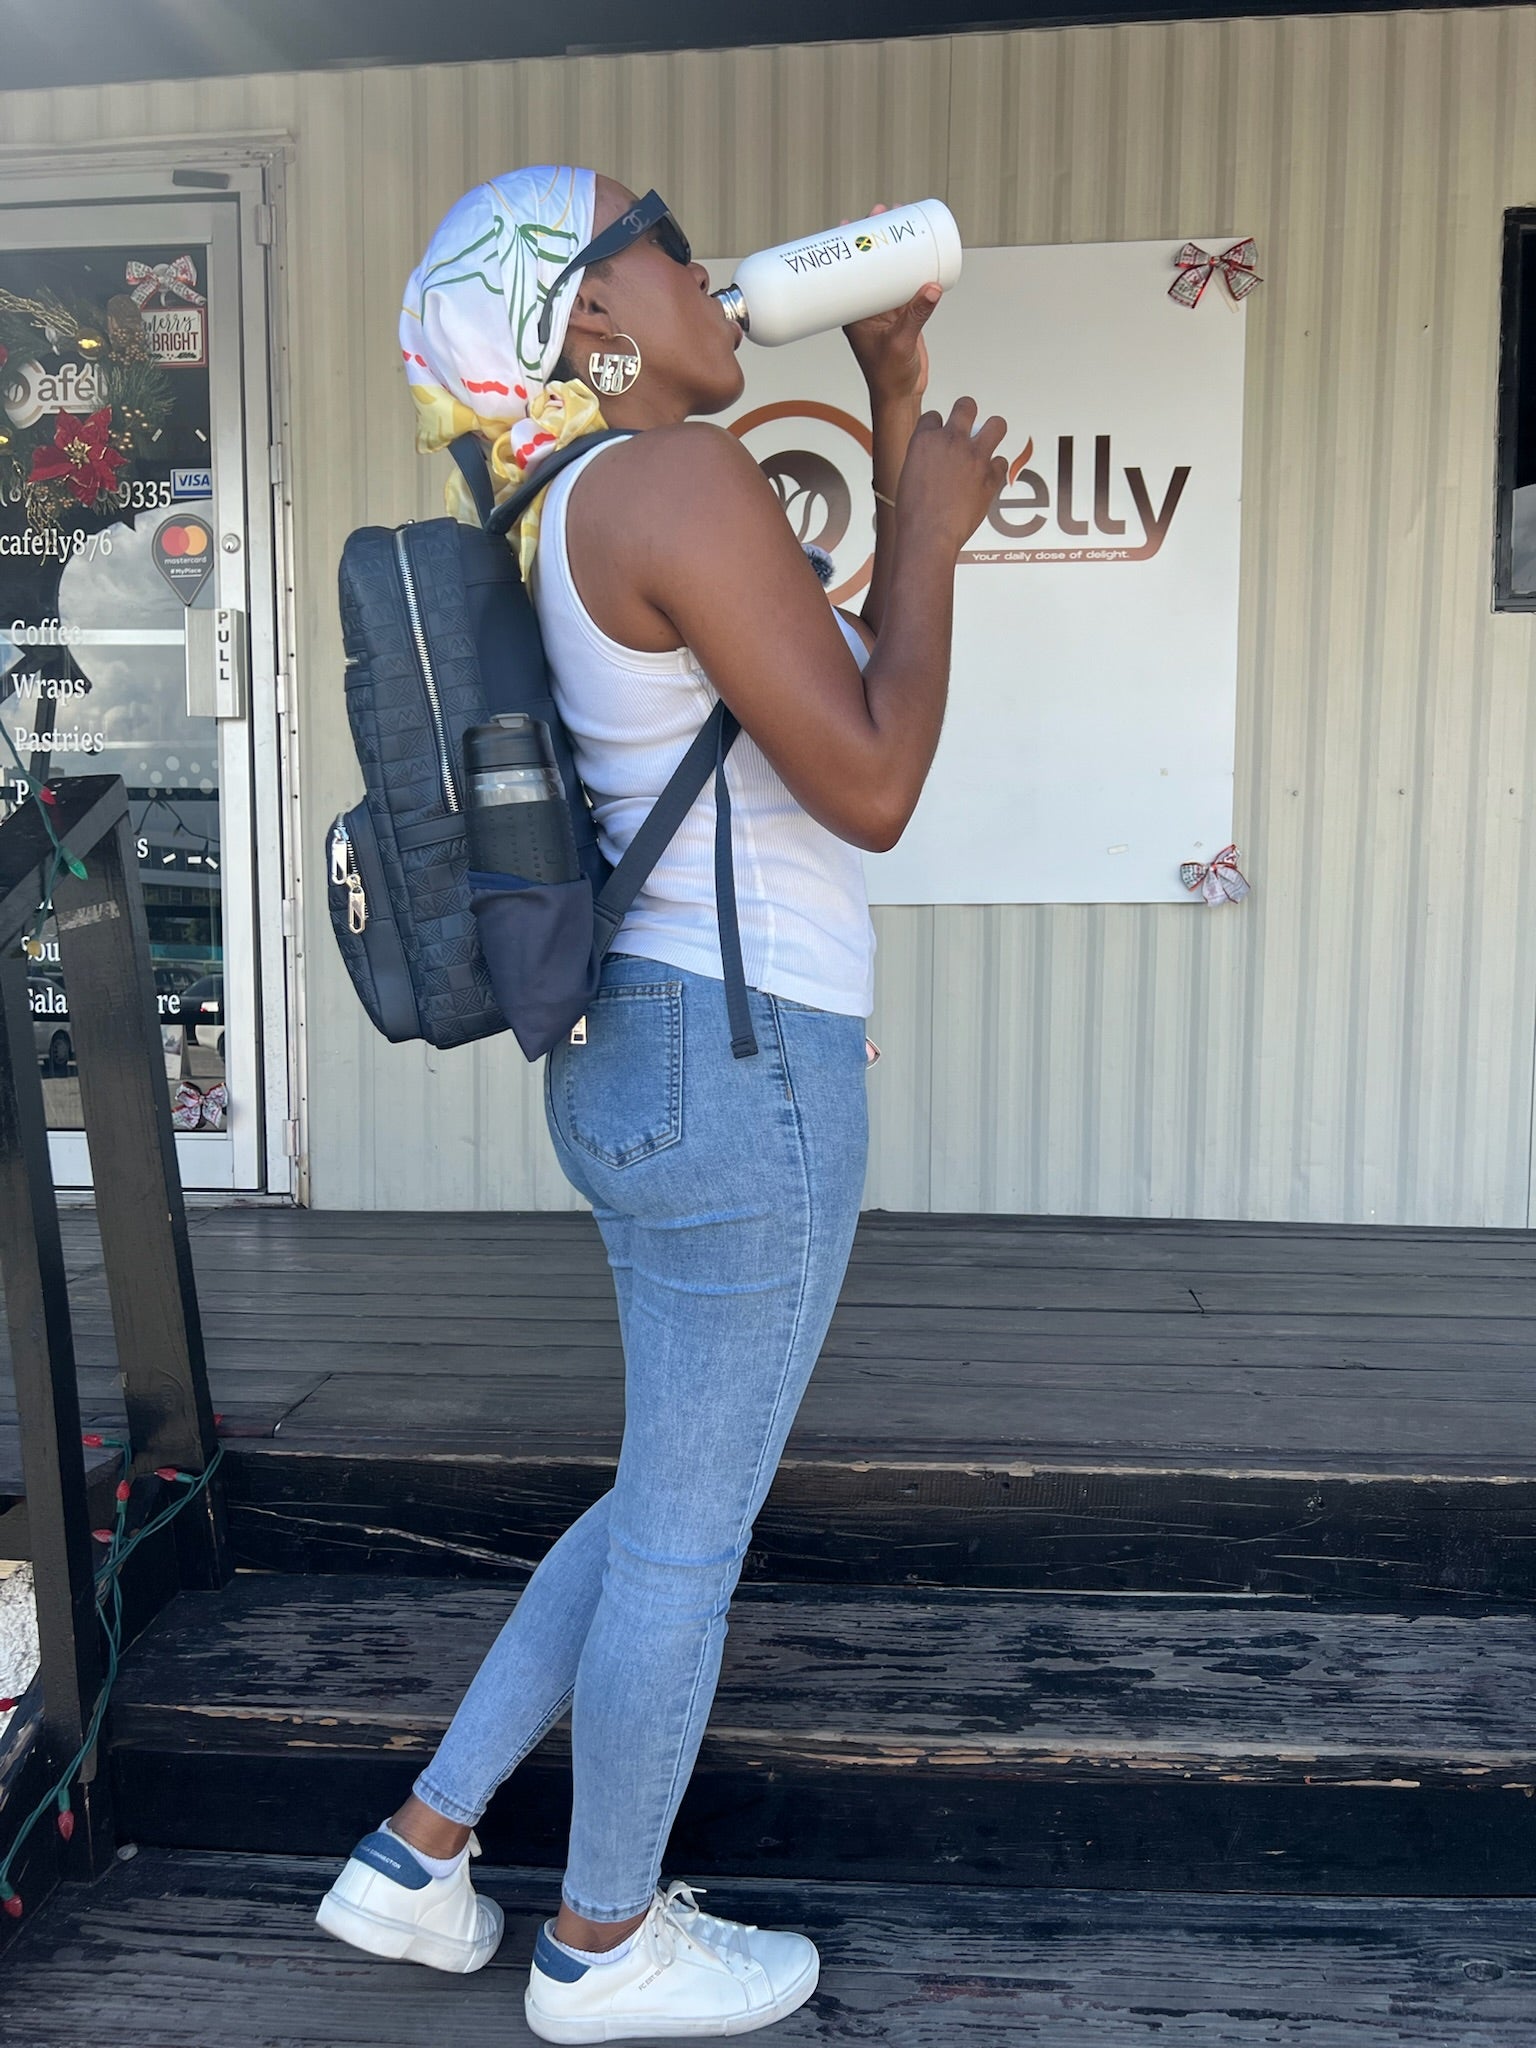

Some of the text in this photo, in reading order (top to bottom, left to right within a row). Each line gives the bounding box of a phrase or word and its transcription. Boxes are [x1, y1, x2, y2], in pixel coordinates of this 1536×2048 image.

[889, 220, 916, 244] MI
[785, 240, 852, 274] FARINA
[152, 332, 199, 351] BRIGHT
[178, 474, 210, 486] VISA
[118, 481, 171, 509] 9335
[164, 556, 207, 565] mastercard
[972, 552, 1000, 561] Your
[1004, 552, 1032, 562] daily
[1035, 551, 1066, 560] dose
[1069, 551, 1084, 560] of
[11, 618, 82, 646] Coffee
[217, 610, 230, 681] PULL
[11, 673, 87, 706] Wraps
[14, 726, 104, 752] Pastries
